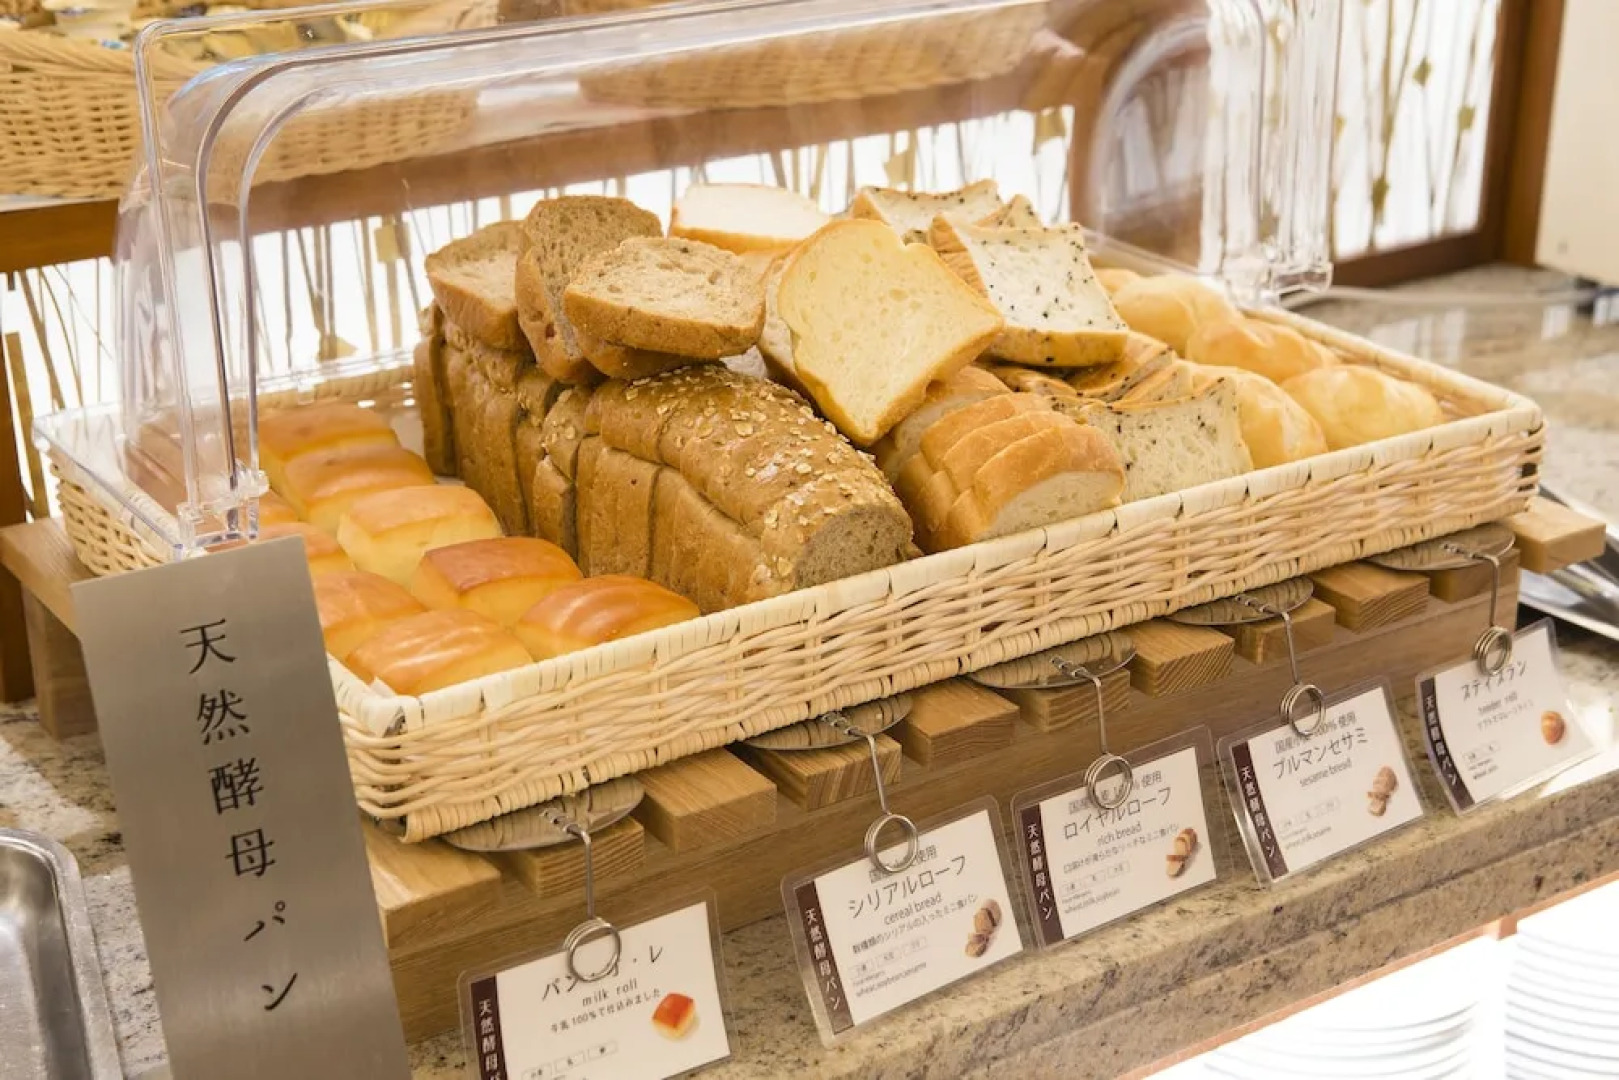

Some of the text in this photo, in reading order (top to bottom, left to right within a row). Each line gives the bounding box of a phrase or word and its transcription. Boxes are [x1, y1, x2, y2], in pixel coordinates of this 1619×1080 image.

[178, 617, 299, 1011] 天然酵母パン
[1063, 786, 1171, 840] ロイヤルローフ
[1115, 820, 1142, 839] bread
[848, 854, 966, 919] シリアルローフ
[883, 890, 943, 926] cereal bread
[582, 977, 638, 1007] milk roll
